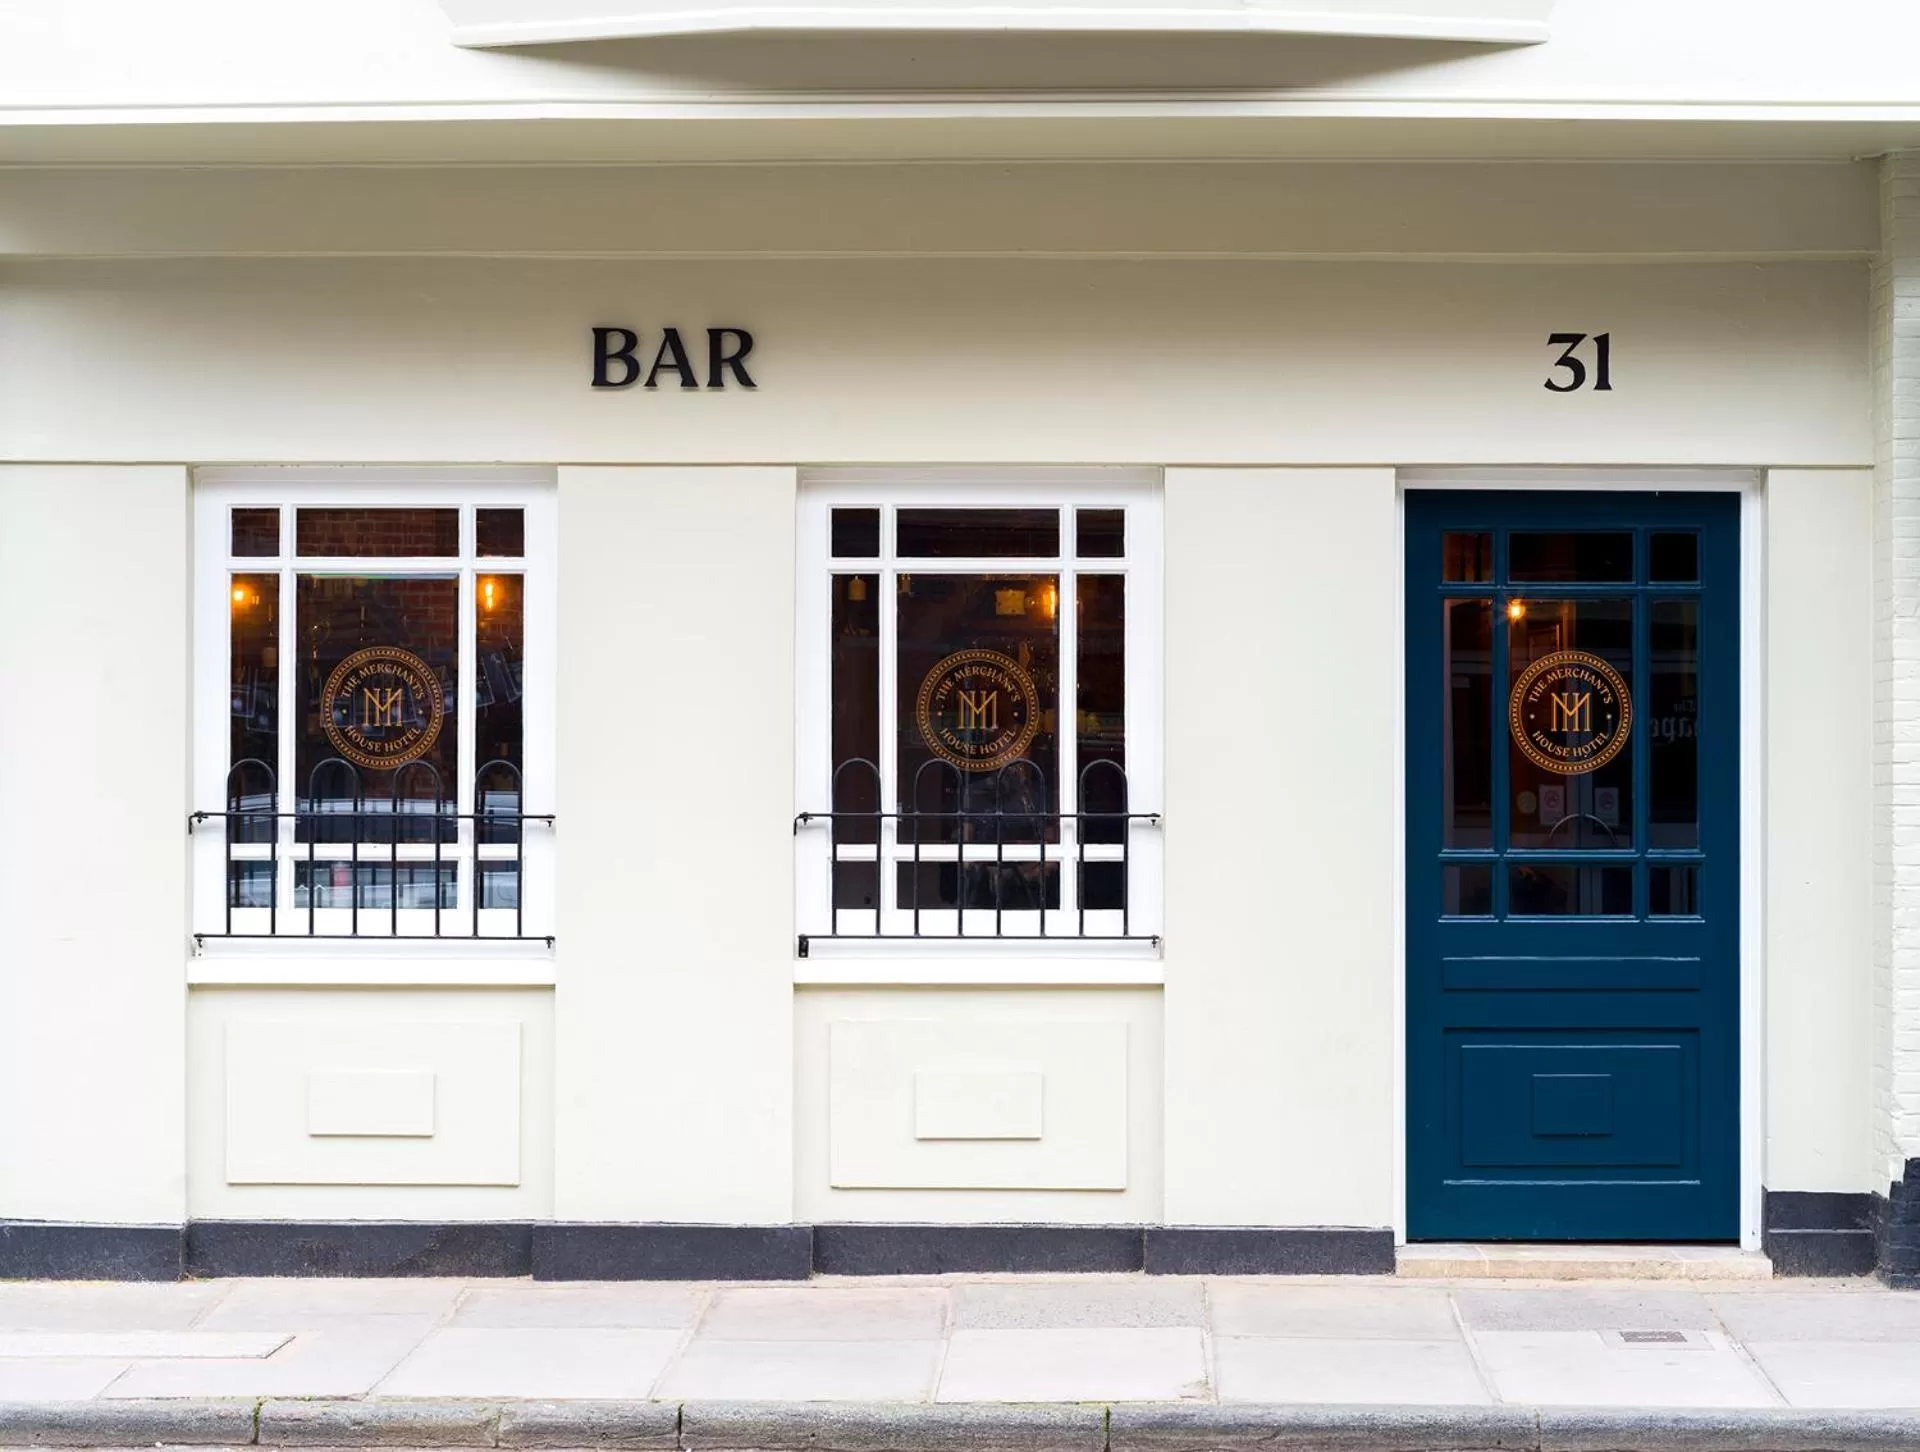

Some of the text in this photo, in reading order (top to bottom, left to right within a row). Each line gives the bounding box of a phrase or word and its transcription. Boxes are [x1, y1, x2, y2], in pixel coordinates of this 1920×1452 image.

[591, 327, 758, 388] BAR
[1544, 332, 1612, 392] 31
[341, 663, 425, 700] THE MERCHANT'S
[935, 677, 955, 701] THE
[1528, 668, 1613, 704] THE MERCHANT'S
[344, 725, 421, 753] HOUSE HOTEL
[940, 727, 1016, 755] HOUSE HOTEL
[1532, 730, 1609, 757] HOUSE HOTEL
